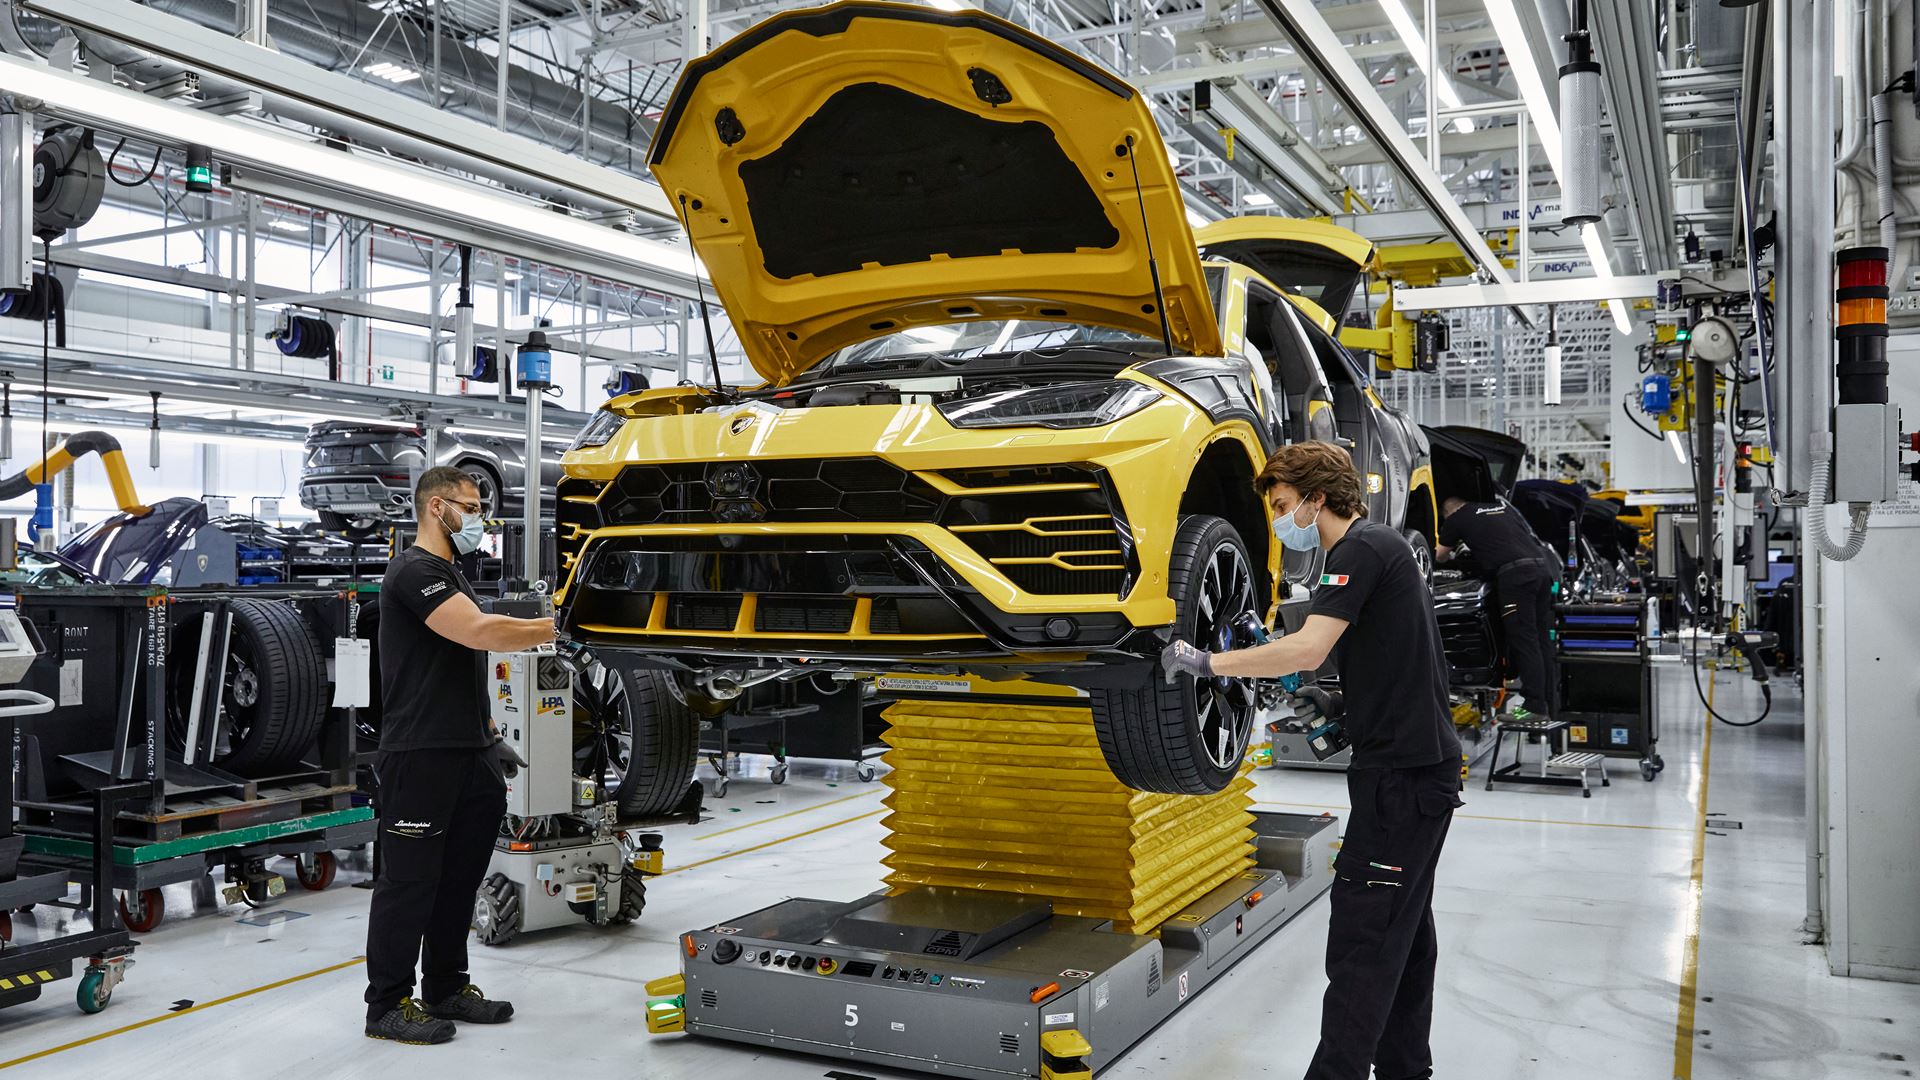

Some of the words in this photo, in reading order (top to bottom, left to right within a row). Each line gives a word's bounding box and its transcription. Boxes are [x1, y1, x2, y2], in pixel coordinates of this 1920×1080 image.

[1503, 205, 1542, 221] INDVA
[1544, 261, 1578, 273] INDEVA
[64, 626, 89, 637] RONT
[148, 652, 155, 666] KG
[500, 684, 512, 696] HPA
[542, 696, 565, 708] HPA
[147, 720, 155, 768] STACKING:
[394, 819, 431, 828] Lamborghini
[925, 946, 959, 956] CPM
[844, 1003, 859, 1026] 5
